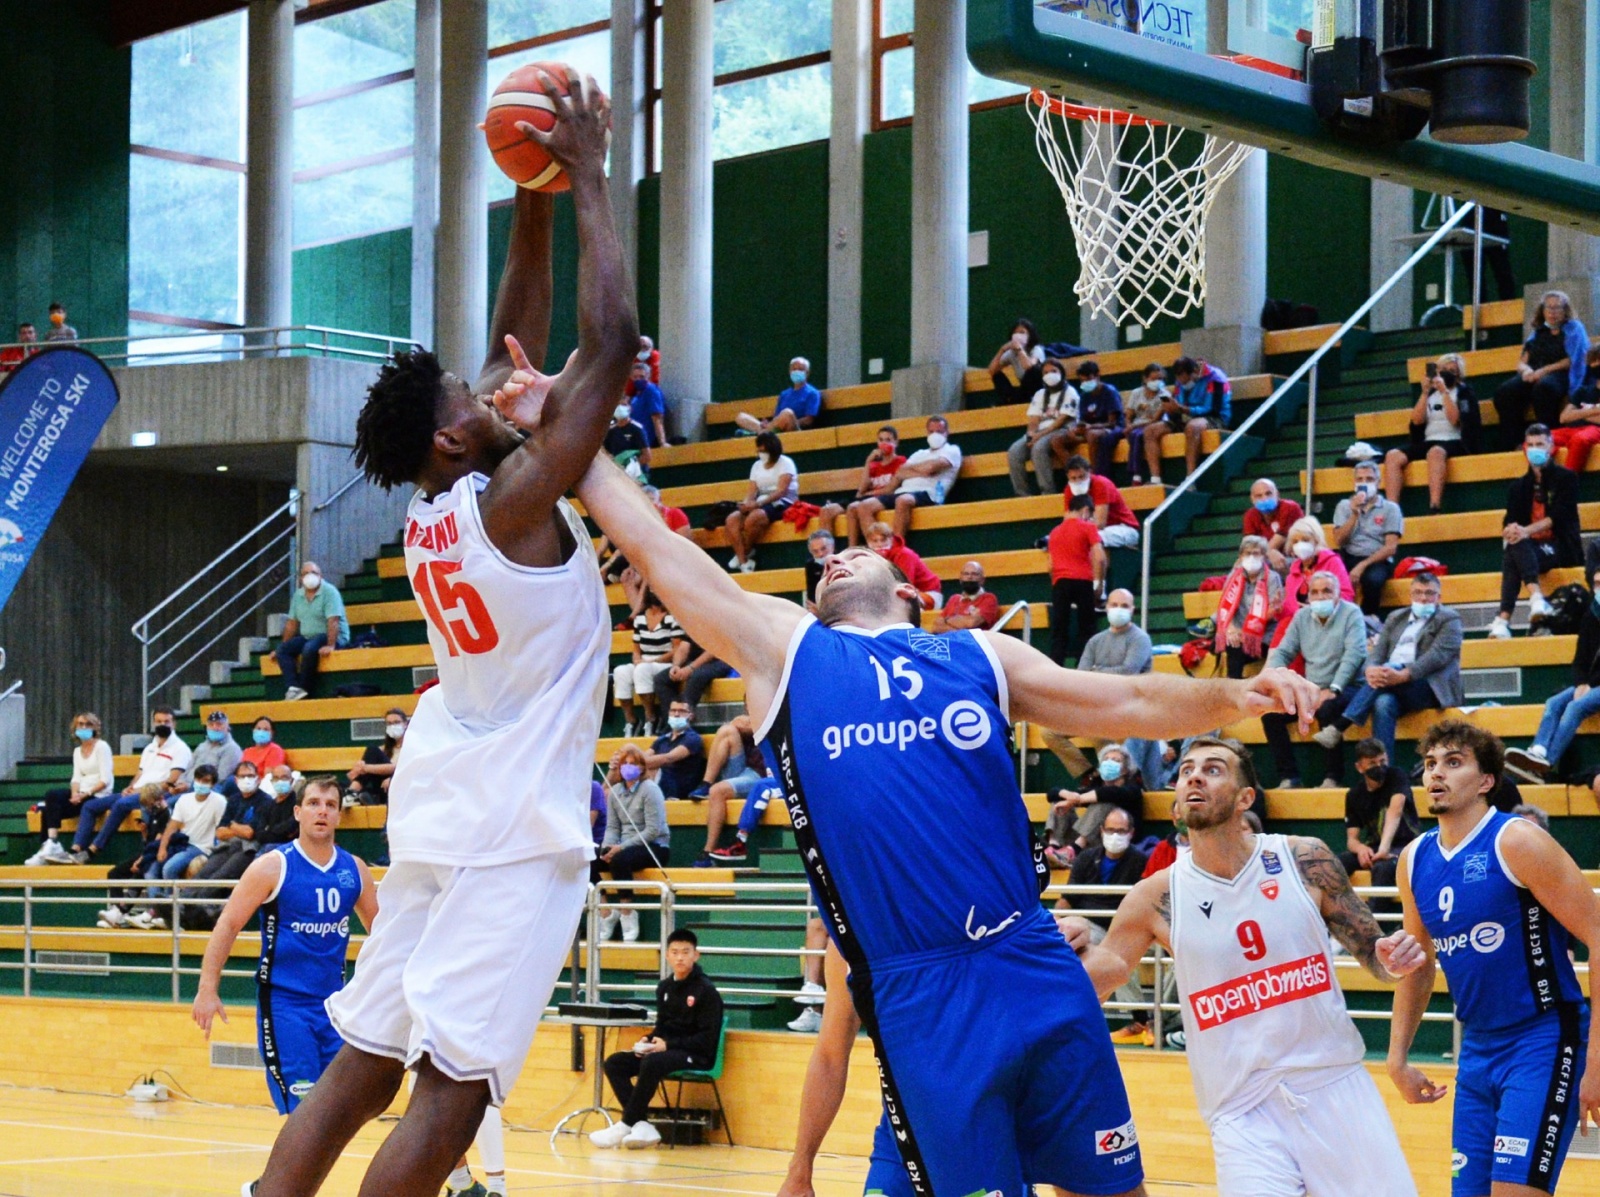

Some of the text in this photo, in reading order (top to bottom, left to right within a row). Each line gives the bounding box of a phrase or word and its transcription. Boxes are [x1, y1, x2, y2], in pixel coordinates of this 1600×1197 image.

[0, 378, 61, 479] WELCOME TO
[5, 404, 73, 511] MONTEROSA
[65, 373, 91, 406] SKI
[413, 559, 499, 657] 15
[869, 655, 923, 701] 15
[822, 717, 937, 760] groupe
[788, 793, 808, 830] FKB
[1034, 842, 1047, 874] BCF
[315, 887, 341, 914] 10
[1438, 886, 1454, 922] 9
[1528, 906, 1540, 930] FKB
[1236, 919, 1267, 961] 9
[1530, 932, 1542, 956] BCF
[1195, 957, 1327, 1023] openjobmetis
[1537, 979, 1552, 1003] FKB
[1555, 1057, 1572, 1103] BCF FKB
[884, 1093, 901, 1125] BCF
[1508, 1139, 1527, 1147] ECAB
[1539, 1125, 1558, 1173] BCF FKB
[906, 1160, 925, 1192] FKB
